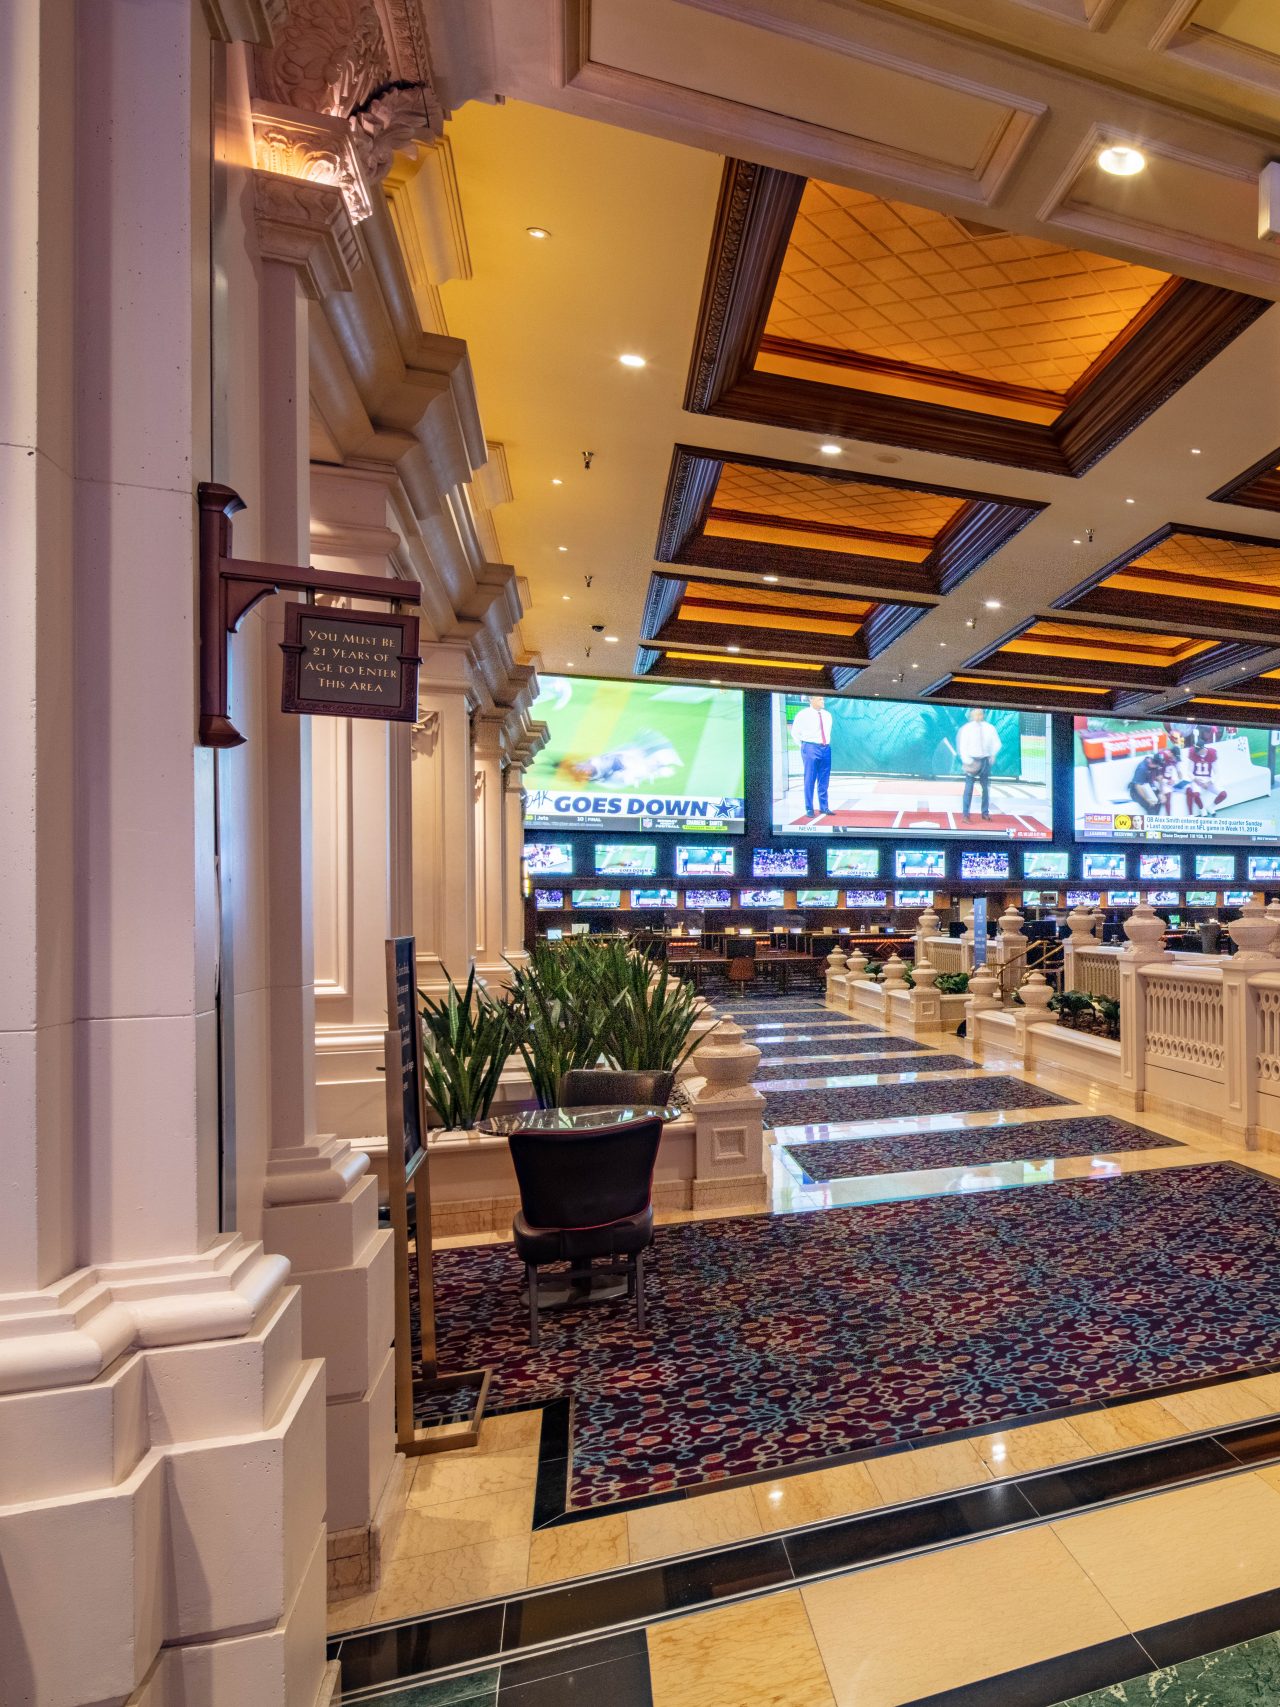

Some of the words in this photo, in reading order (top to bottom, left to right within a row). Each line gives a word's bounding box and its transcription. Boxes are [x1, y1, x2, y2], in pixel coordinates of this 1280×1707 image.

[308, 630, 337, 642] YOU
[342, 634, 377, 646] MUST
[382, 638, 396, 648] BE
[313, 647, 326, 656] 21
[332, 648, 370, 660] YEARS
[373, 653, 389, 663] OF
[304, 662, 333, 673] AGE
[338, 665, 354, 675] TO
[359, 667, 397, 679] ENTER
[318, 678, 345, 689] THIS
[349, 682, 383, 693] AREA
[554, 796, 622, 814] GOES
[626, 798, 709, 817] DOWN
